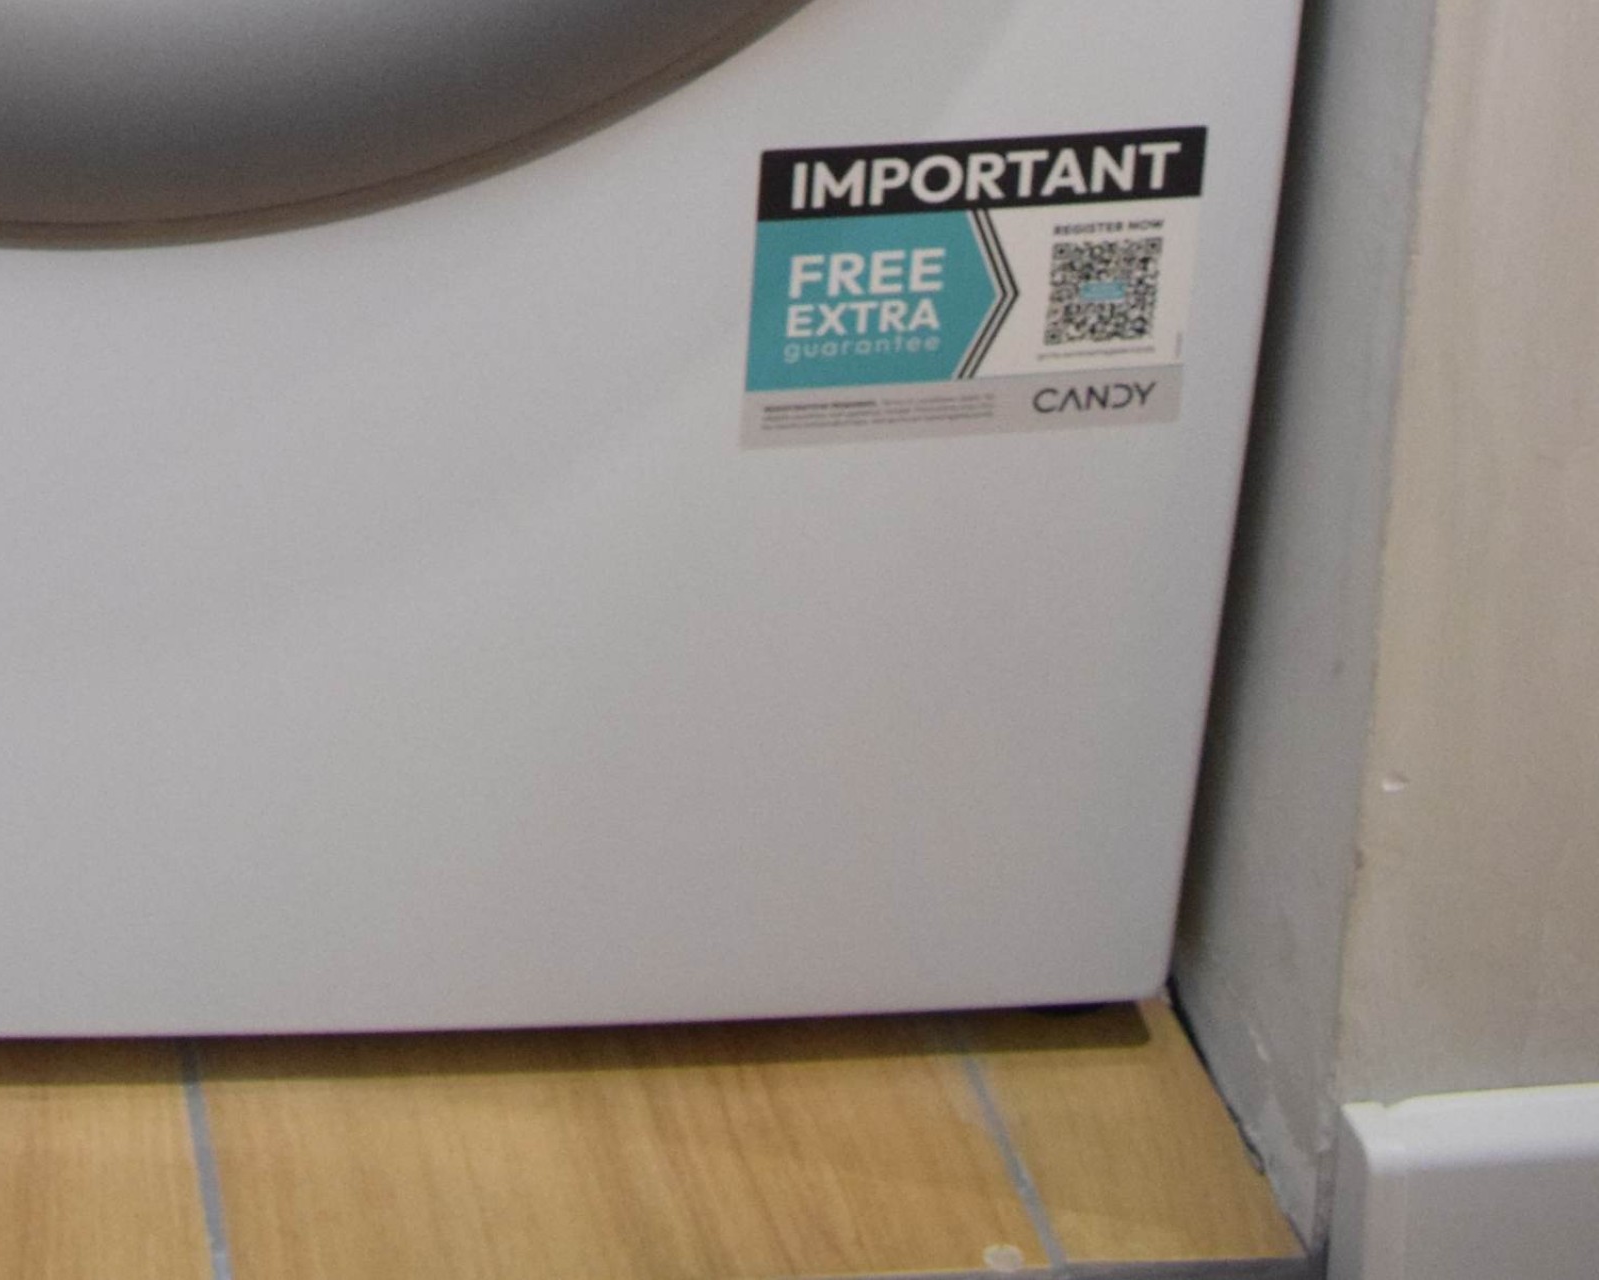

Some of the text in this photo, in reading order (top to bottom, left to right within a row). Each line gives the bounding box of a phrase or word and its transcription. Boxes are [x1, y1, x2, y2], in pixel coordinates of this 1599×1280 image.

[790, 141, 1182, 210] IMPORTANT
[1054, 219, 1164, 236] REGISTER NOW
[788, 247, 947, 299] FREE
[786, 299, 941, 338] EXTRA
[783, 333, 941, 364] guarantee
[1032, 382, 1157, 414] CANDY
